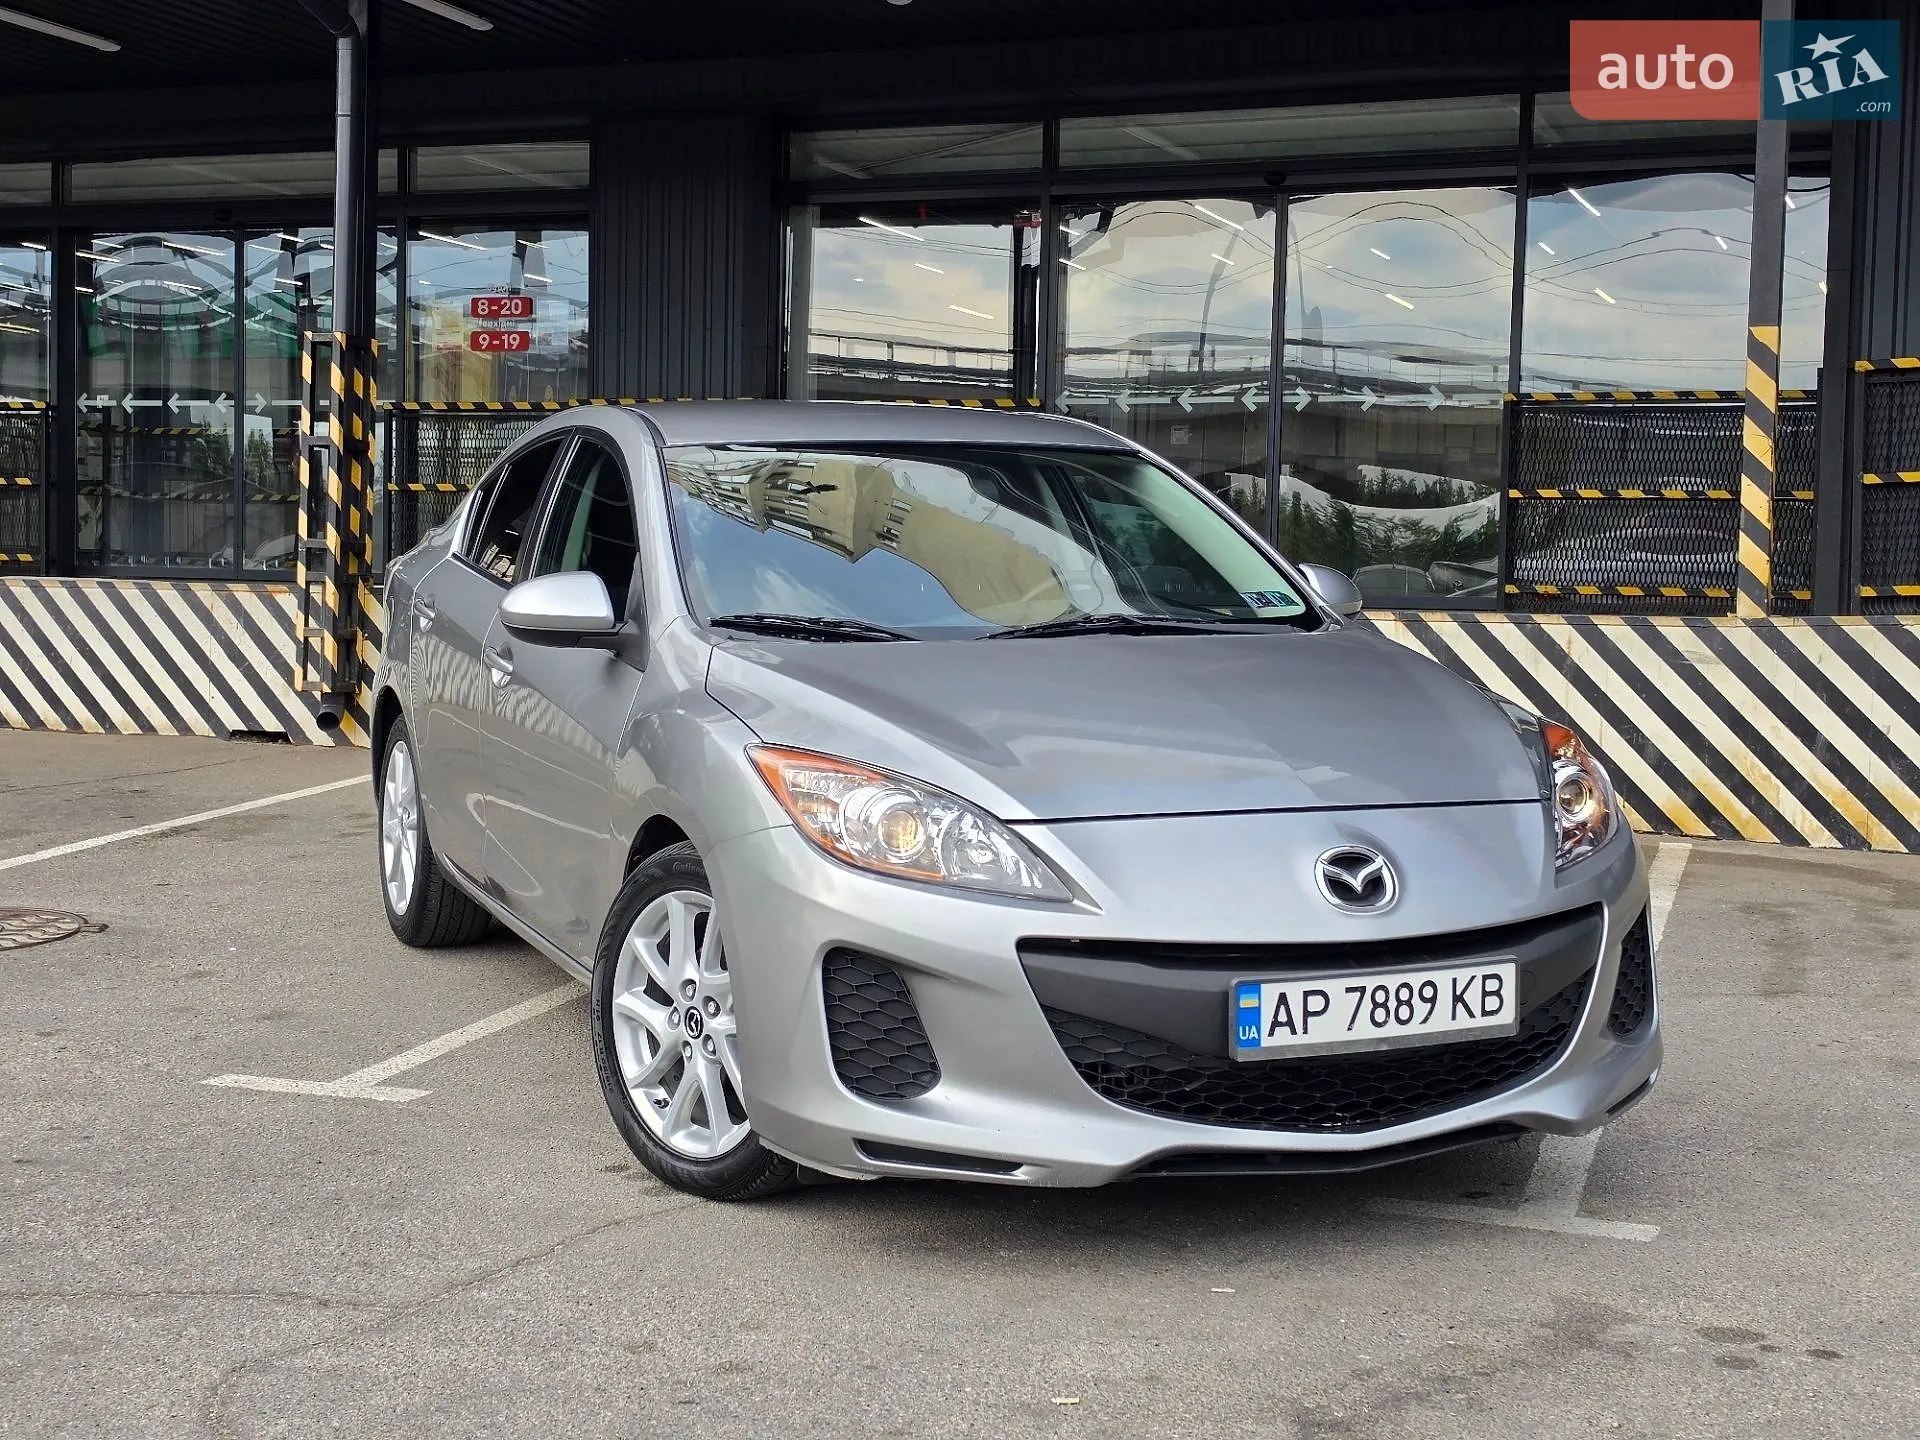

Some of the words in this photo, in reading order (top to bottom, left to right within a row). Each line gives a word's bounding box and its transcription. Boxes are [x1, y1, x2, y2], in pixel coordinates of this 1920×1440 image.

[477, 299, 522, 315] 8-20
[478, 333, 520, 350] 9-19
[1267, 988, 1330, 1038] AP
[1345, 979, 1439, 1031] 7889
[1450, 972, 1504, 1021] KB
[1239, 1025, 1259, 1041] UA
